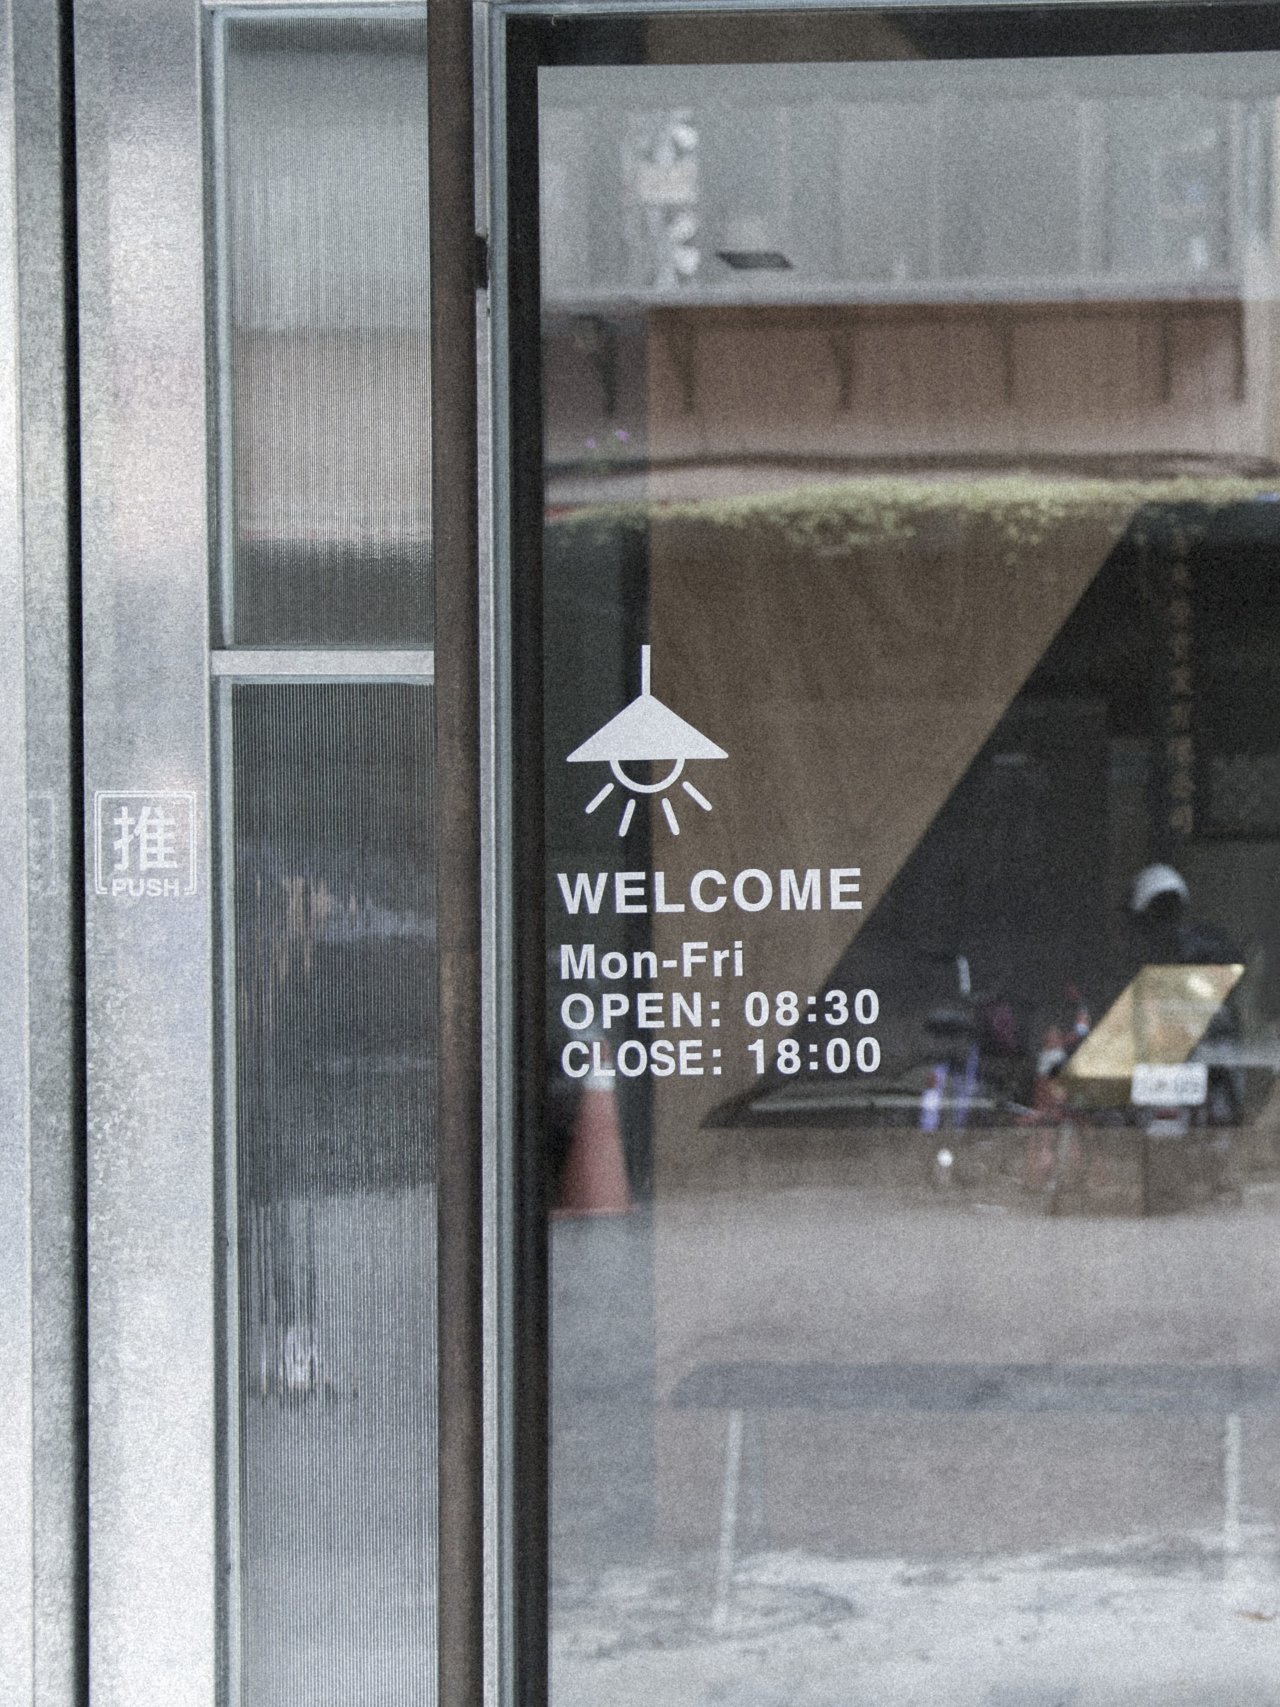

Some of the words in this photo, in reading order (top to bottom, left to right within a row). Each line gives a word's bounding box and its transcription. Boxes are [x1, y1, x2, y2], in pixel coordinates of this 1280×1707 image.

[113, 806, 178, 872] 推
[112, 878, 180, 897] PUSH
[557, 867, 863, 915] WELCOME
[560, 940, 744, 980] Mon-Fri
[560, 991, 721, 1030] OPEN:
[744, 989, 880, 1027] 08:30
[561, 1039, 722, 1078] CLOSE:
[748, 1036, 882, 1075] 18:00
